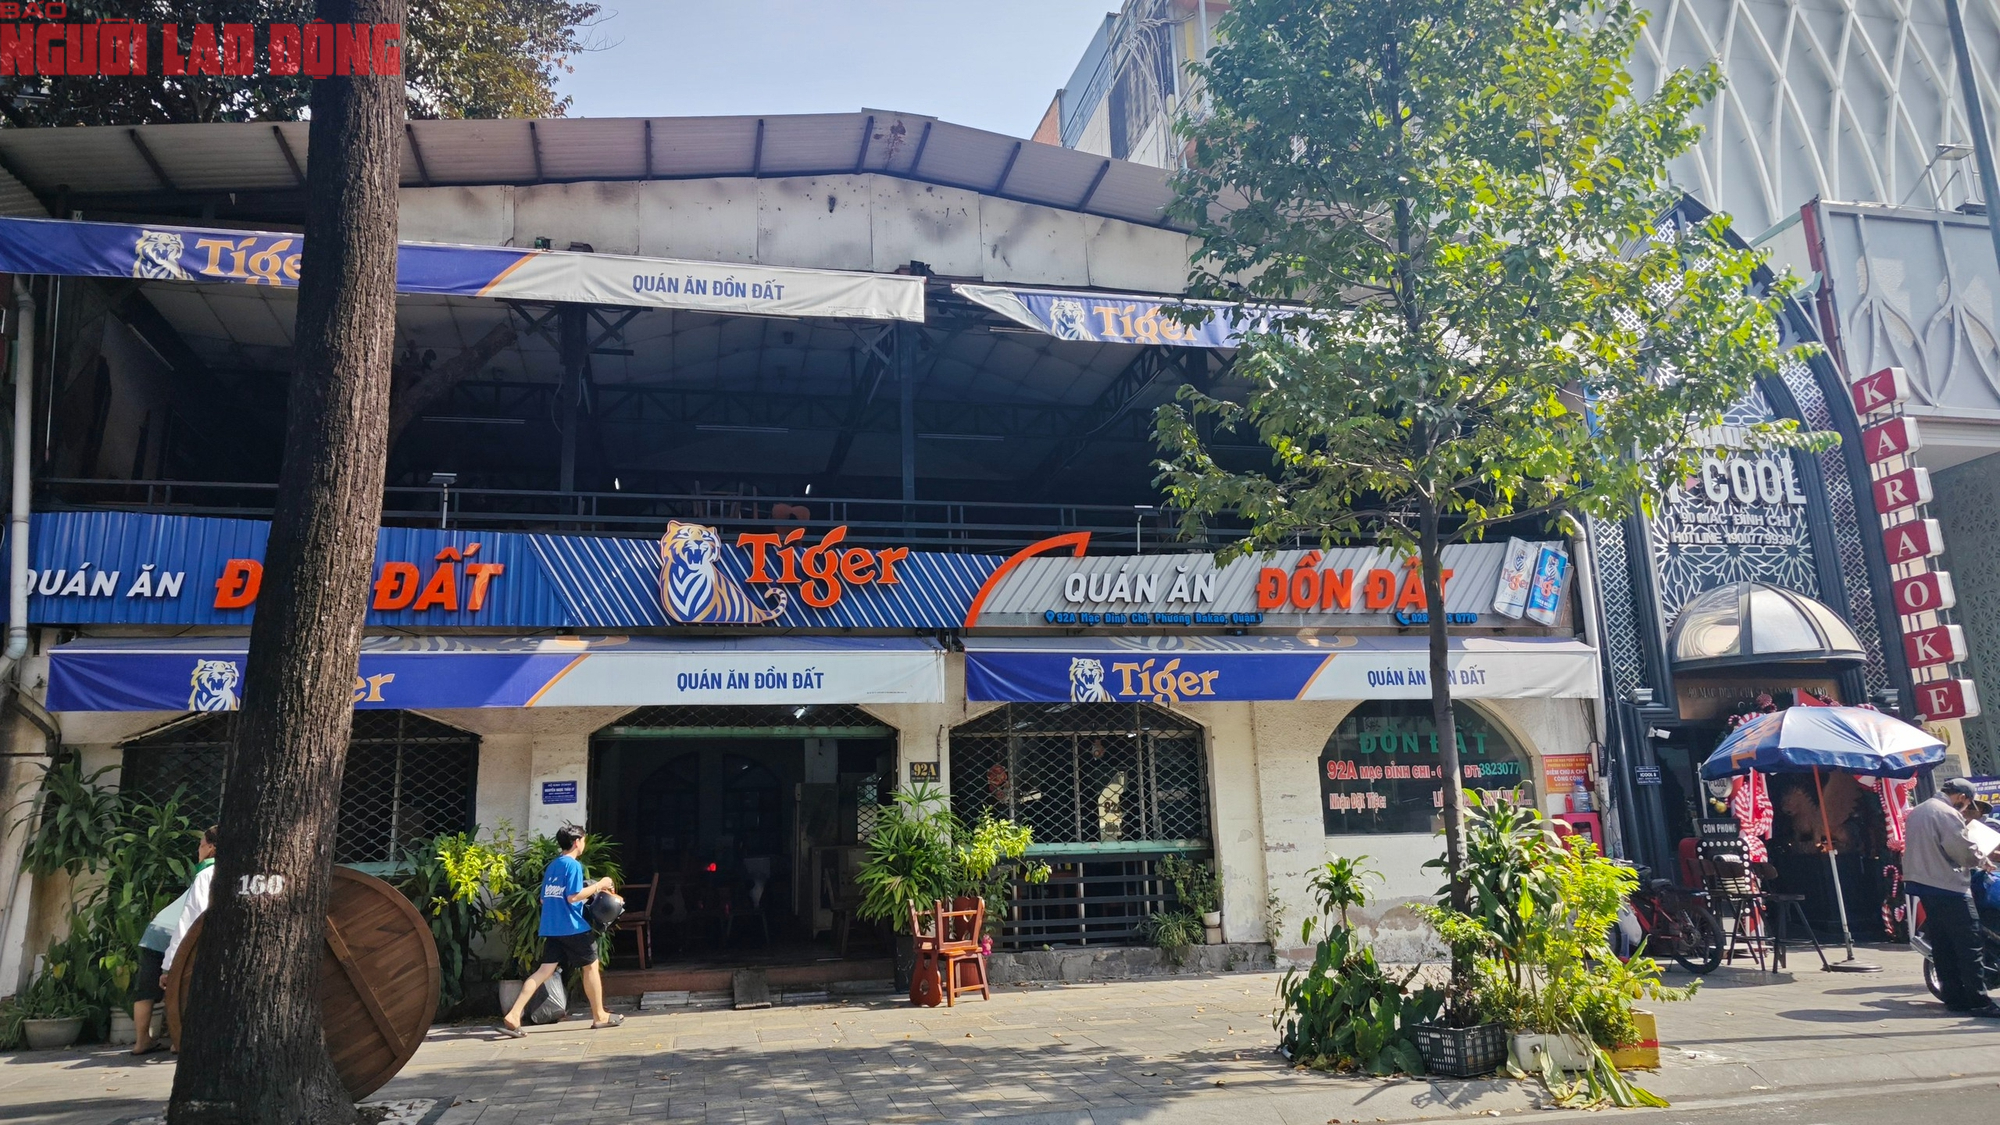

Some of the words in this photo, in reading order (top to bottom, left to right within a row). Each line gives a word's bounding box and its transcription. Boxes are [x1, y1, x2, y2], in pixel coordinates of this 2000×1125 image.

[195, 237, 302, 285] Tige
[632, 273, 679, 293] QUÁN
[683, 274, 707, 295] ĂN
[712, 276, 746, 298] ĐỒN
[751, 279, 784, 300] ĐẤT
[1702, 457, 1807, 504] COOL
[1766, 515, 1791, 527] CHI
[1671, 531, 1723, 544] HOTLINE
[1861, 376, 1956, 717] KARAOKE
[372, 542, 504, 611] ĐẤT
[736, 525, 909, 608] Tiger
[126, 563, 185, 598] ĂN
[1064, 564, 1159, 604] QUÁN
[1166, 565, 1216, 603] ĂN
[1256, 550, 1353, 610] ĐỒN
[1057, 612, 1075, 623] 92A
[1080, 612, 1100, 625] Mạc
[1455, 612, 1478, 624] 0770
[677, 668, 722, 691] QUÁN
[726, 669, 749, 689] ĂN
[754, 666, 787, 689] ĐỒN
[793, 667, 824, 689] ĐẤT
[1111, 658, 1219, 702] Tiger
[1368, 667, 1404, 687] QUÁN
[1408, 667, 1427, 686] ĂN
[1461, 664, 1486, 685] ĐẤT
[914, 763, 936, 776] 92A
[1327, 760, 1358, 780] 92A
[1360, 766, 1383, 783] MẠC
[1412, 765, 1430, 779] CHI
[238, 874, 285, 895] 160
